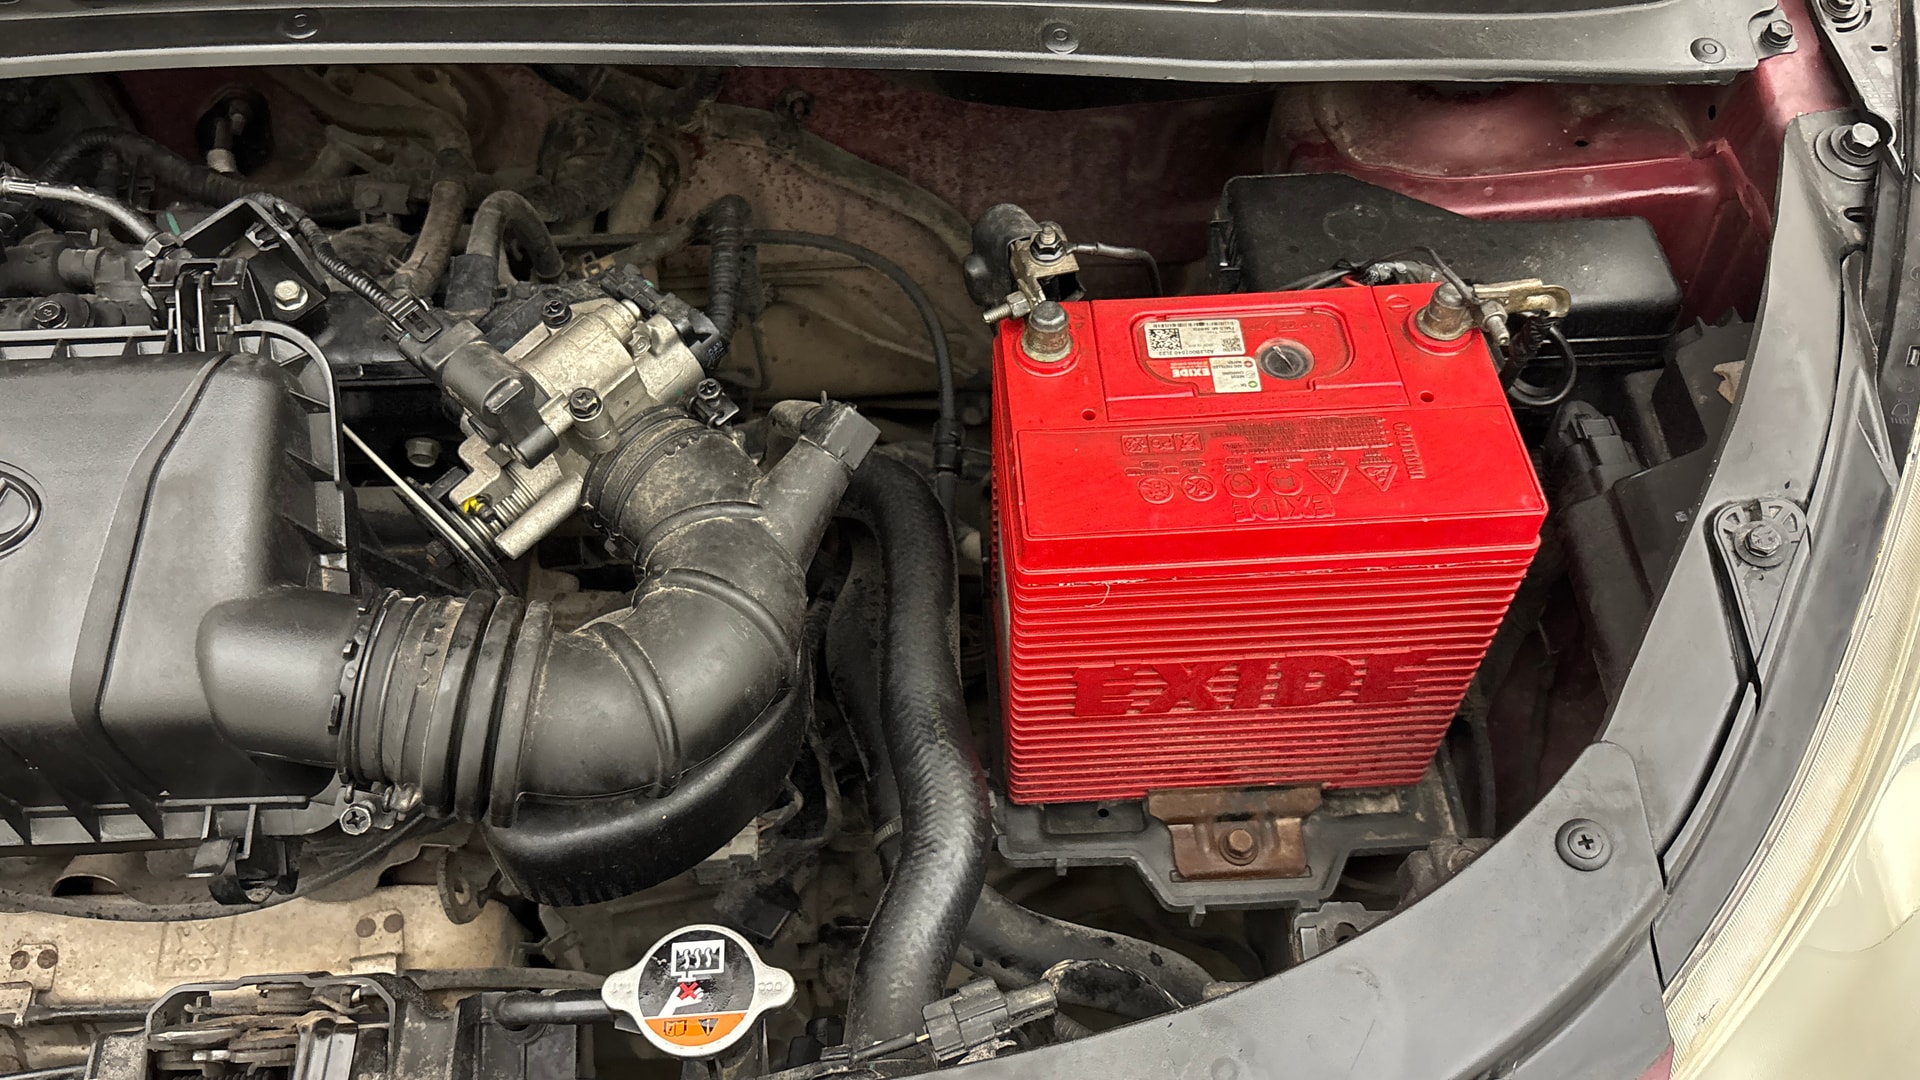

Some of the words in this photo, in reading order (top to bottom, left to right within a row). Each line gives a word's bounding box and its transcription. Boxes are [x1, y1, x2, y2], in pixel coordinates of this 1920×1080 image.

[1172, 368, 1211, 378] EXIDE
[1231, 494, 1336, 522] EXIDE
[1073, 647, 1440, 717] EXIDE
